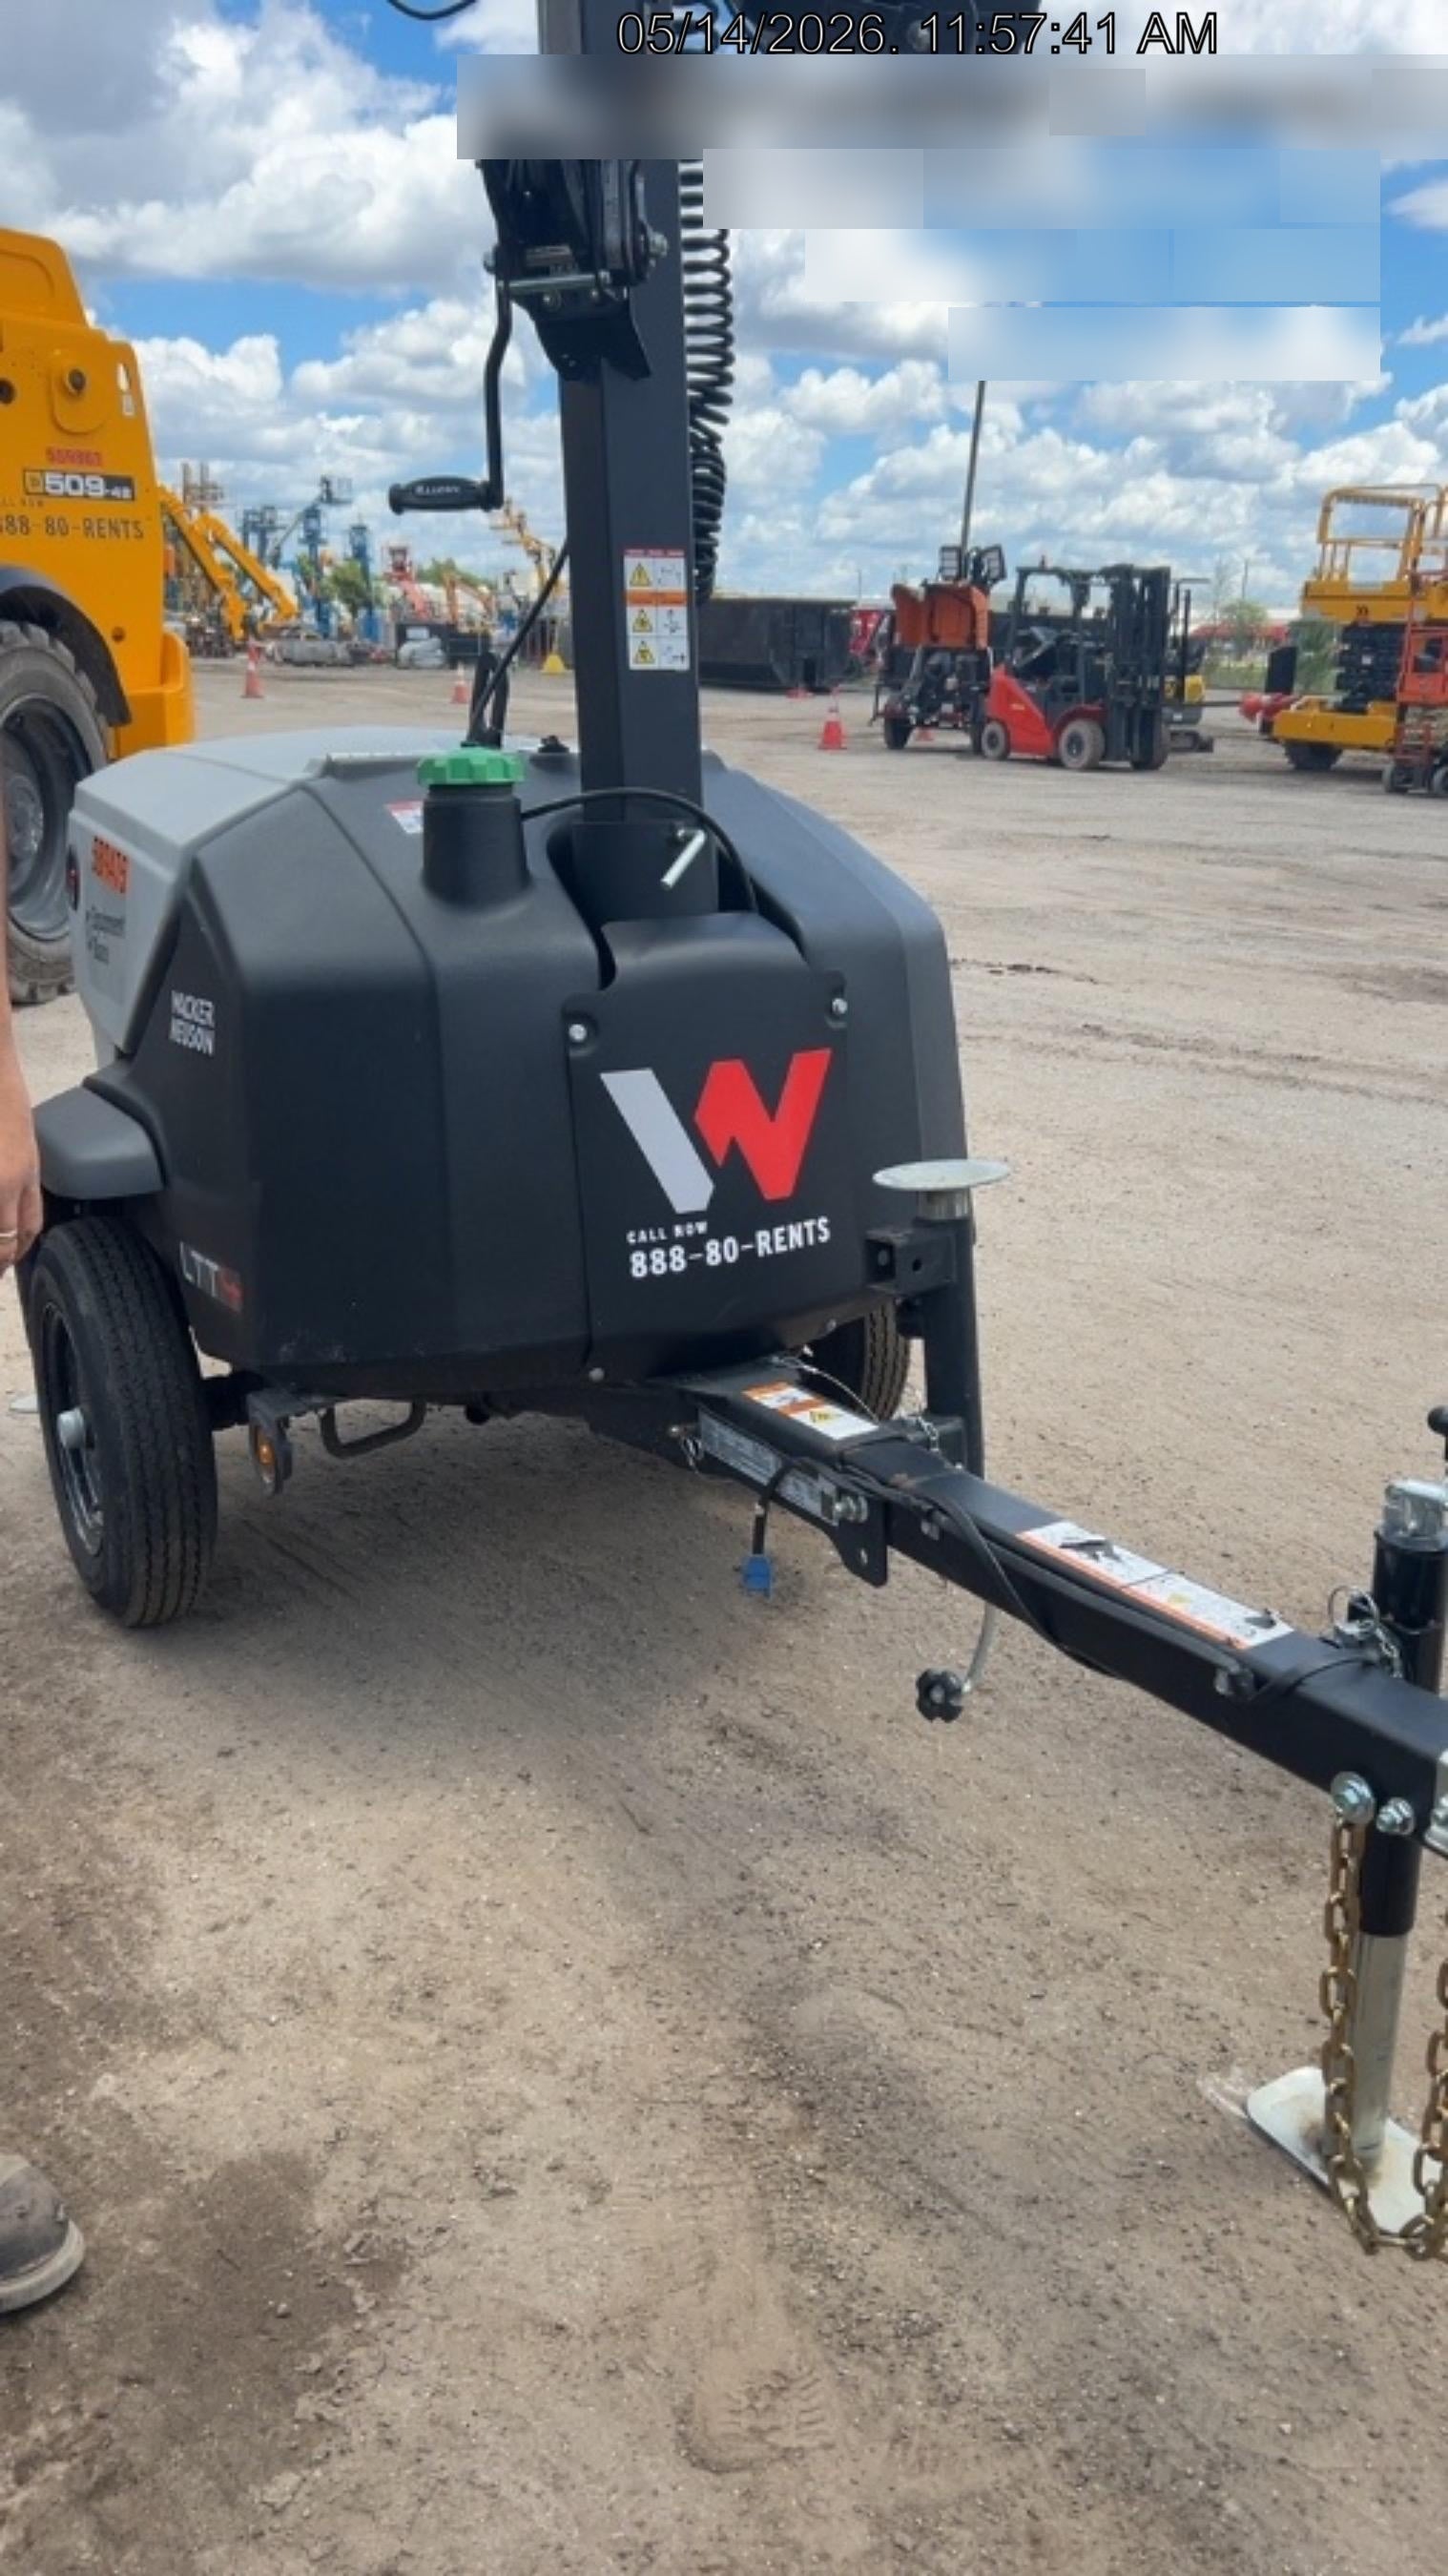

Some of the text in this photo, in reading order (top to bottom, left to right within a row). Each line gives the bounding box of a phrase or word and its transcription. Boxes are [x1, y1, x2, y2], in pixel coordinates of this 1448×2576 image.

[626, 1220, 708, 1244] CALL NOW
[629, 1215, 832, 1278] 888-80-RENTS
